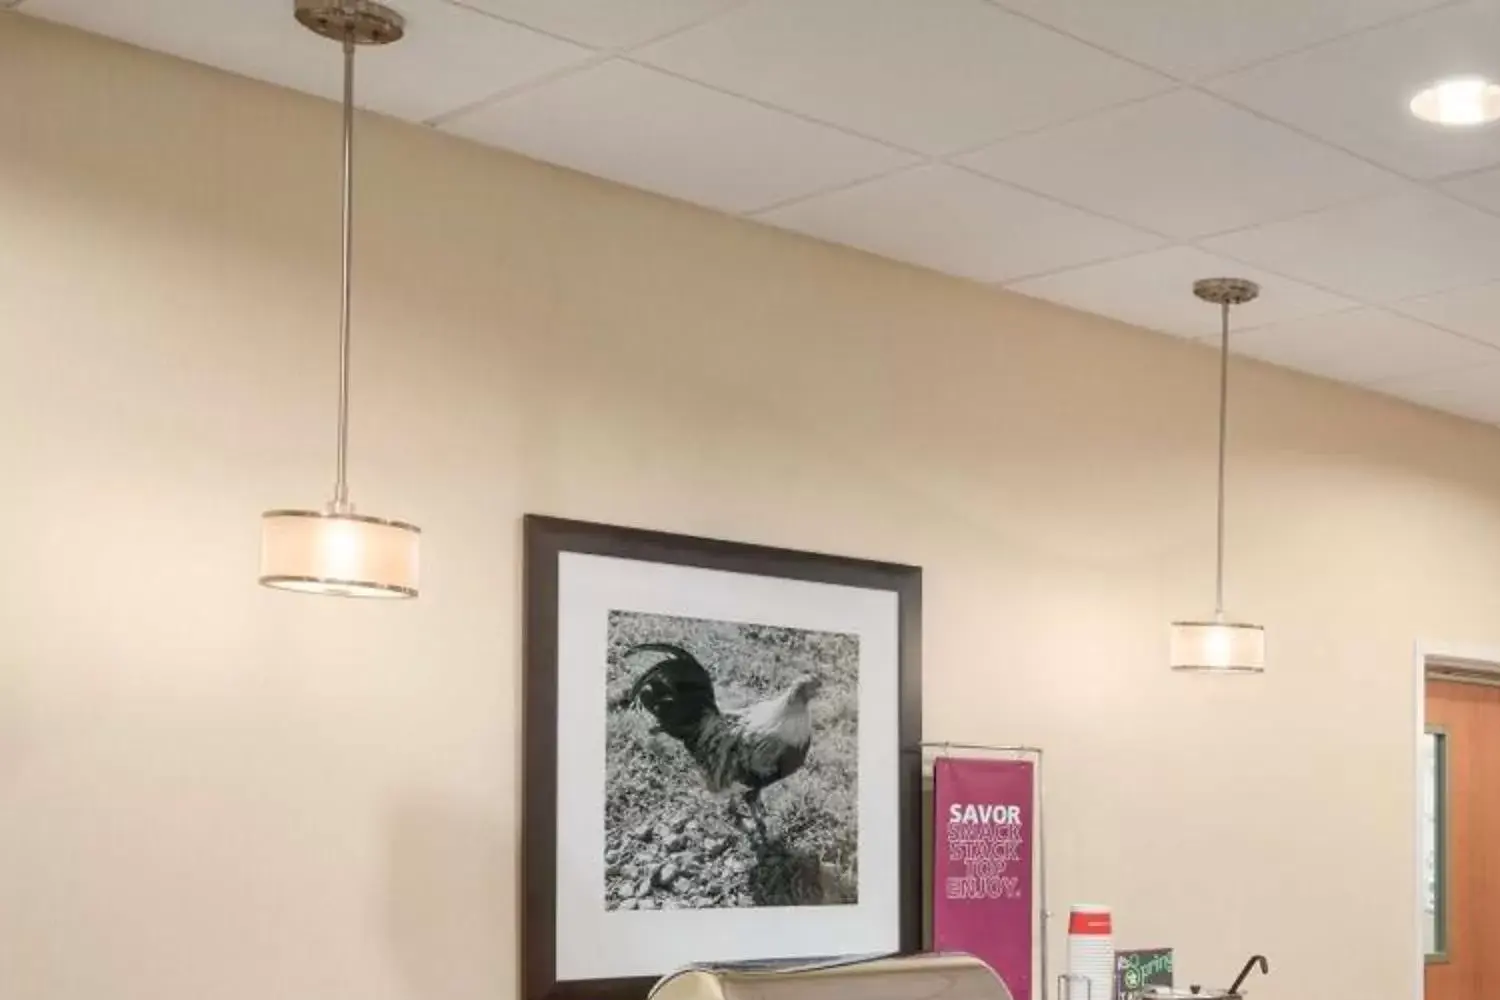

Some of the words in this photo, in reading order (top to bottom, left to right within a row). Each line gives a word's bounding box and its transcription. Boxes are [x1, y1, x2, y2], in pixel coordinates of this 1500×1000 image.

[949, 803, 1021, 824] SAVOR
[949, 840, 1020, 860] STACK
[963, 858, 1007, 879] TOP
[946, 876, 1021, 899] ENJOY.
